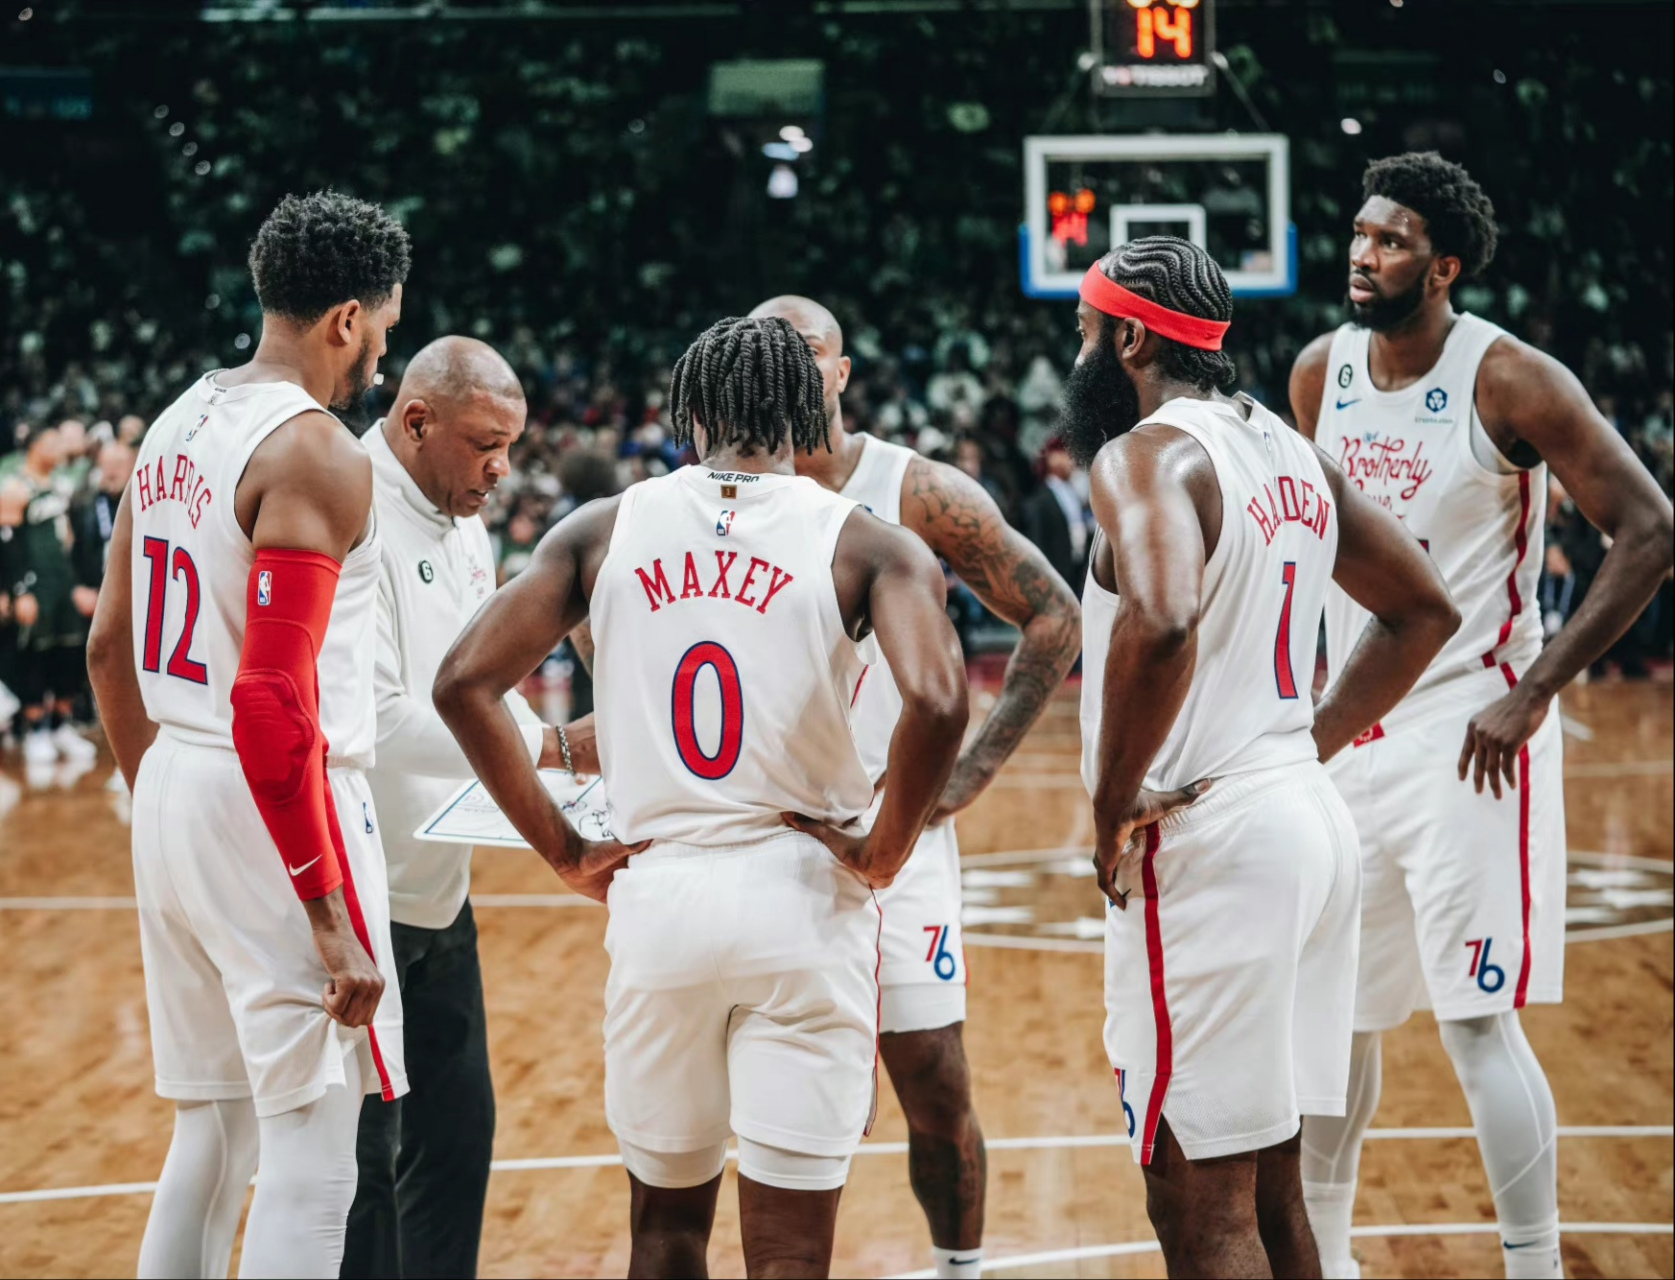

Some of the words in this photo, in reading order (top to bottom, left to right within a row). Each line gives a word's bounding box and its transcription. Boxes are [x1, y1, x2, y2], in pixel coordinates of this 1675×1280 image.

[1137, 7, 1191, 58] 14
[707, 471, 734, 482] NIKE
[734, 473, 760, 483] PRO
[1340, 434, 1432, 500] Brotherly
[1247, 476, 1330, 547] HADEN
[419, 560, 433, 584] 6
[634, 550, 794, 615] MAXEY
[142, 535, 208, 686] 12
[1273, 561, 1299, 700] 1
[671, 640, 744, 781] 0
[923, 925, 956, 981] 76
[1464, 937, 1506, 994] 76
